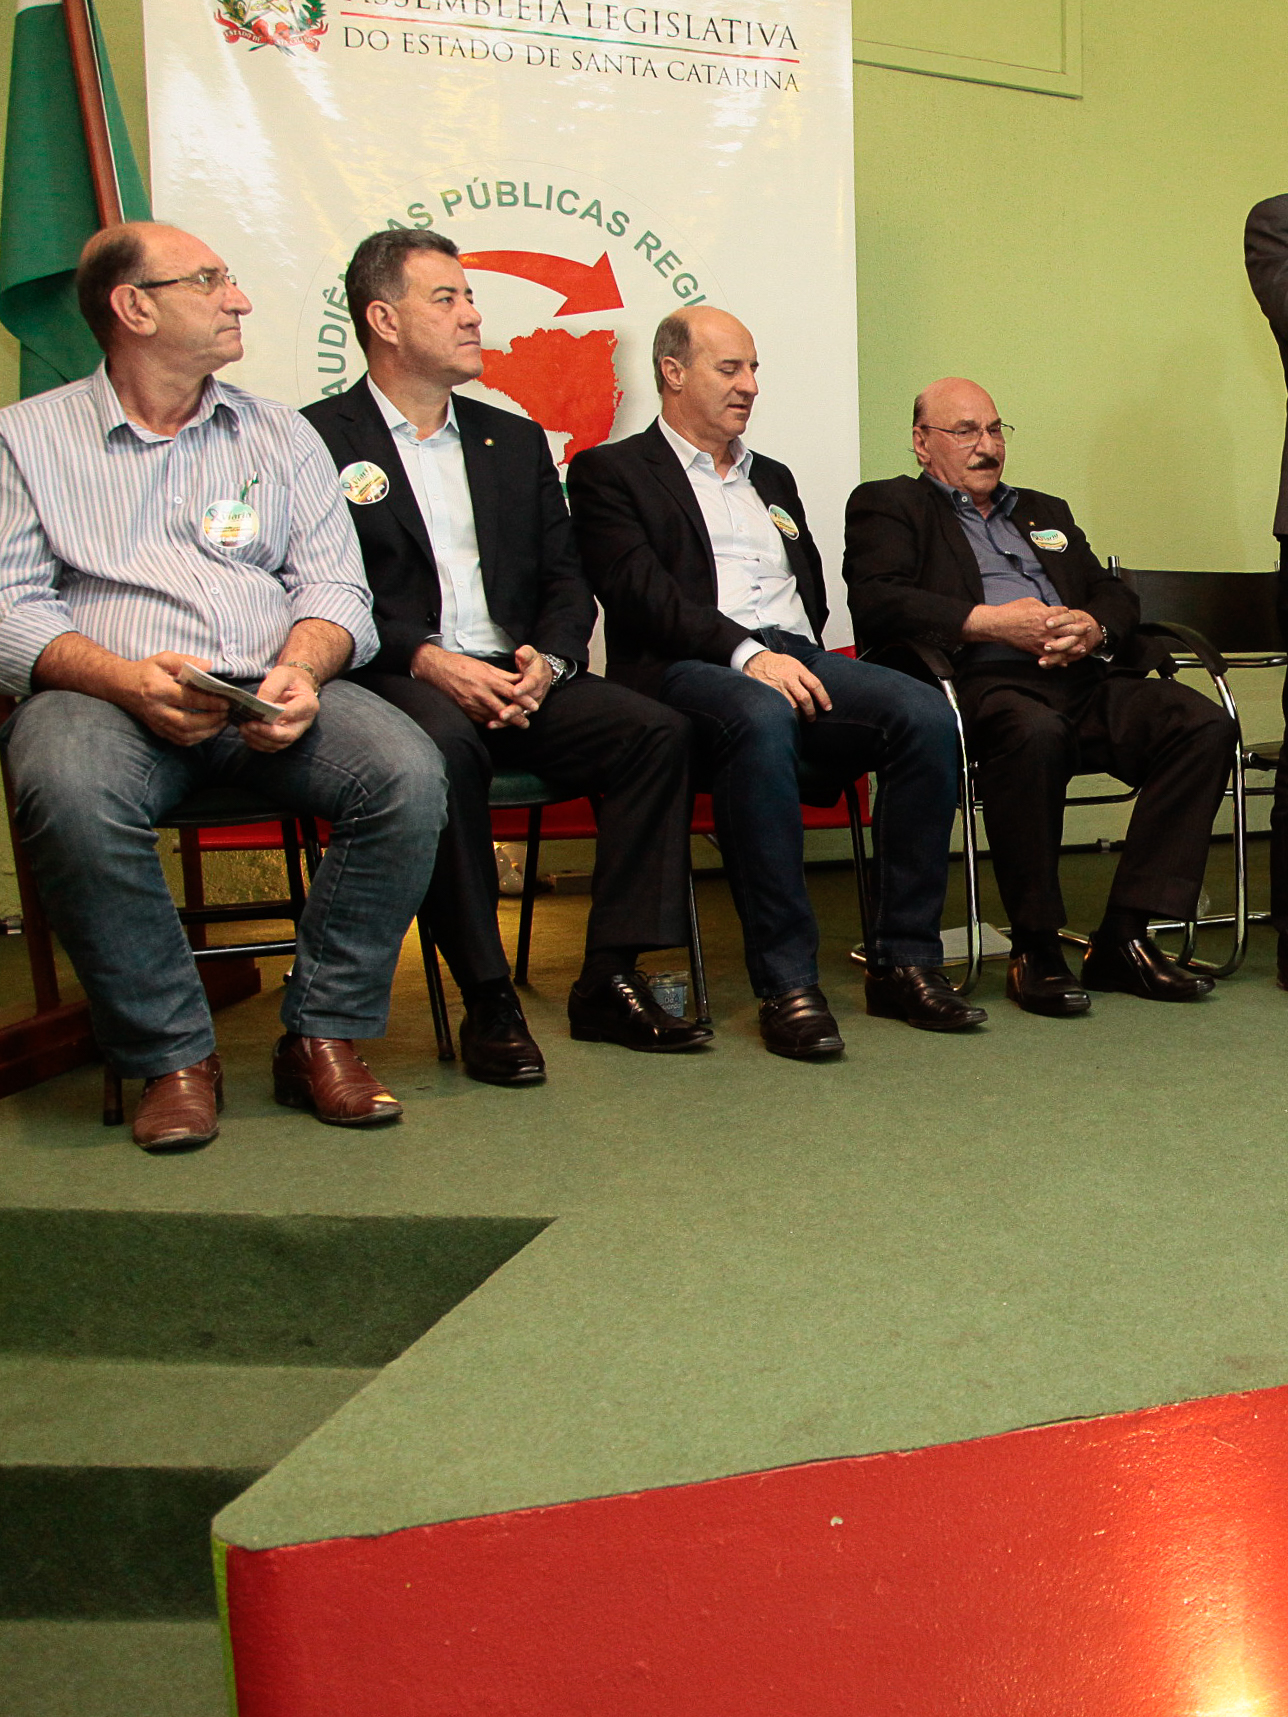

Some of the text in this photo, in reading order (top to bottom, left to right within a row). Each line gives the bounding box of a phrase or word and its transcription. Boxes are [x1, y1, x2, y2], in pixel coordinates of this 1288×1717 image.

[346, 0, 799, 50] BLEIA LEGISLATIVA
[344, 26, 800, 93] DO ESTADO DE SANTA CATARINA
[440, 176, 630, 237] PÚBLICAS
